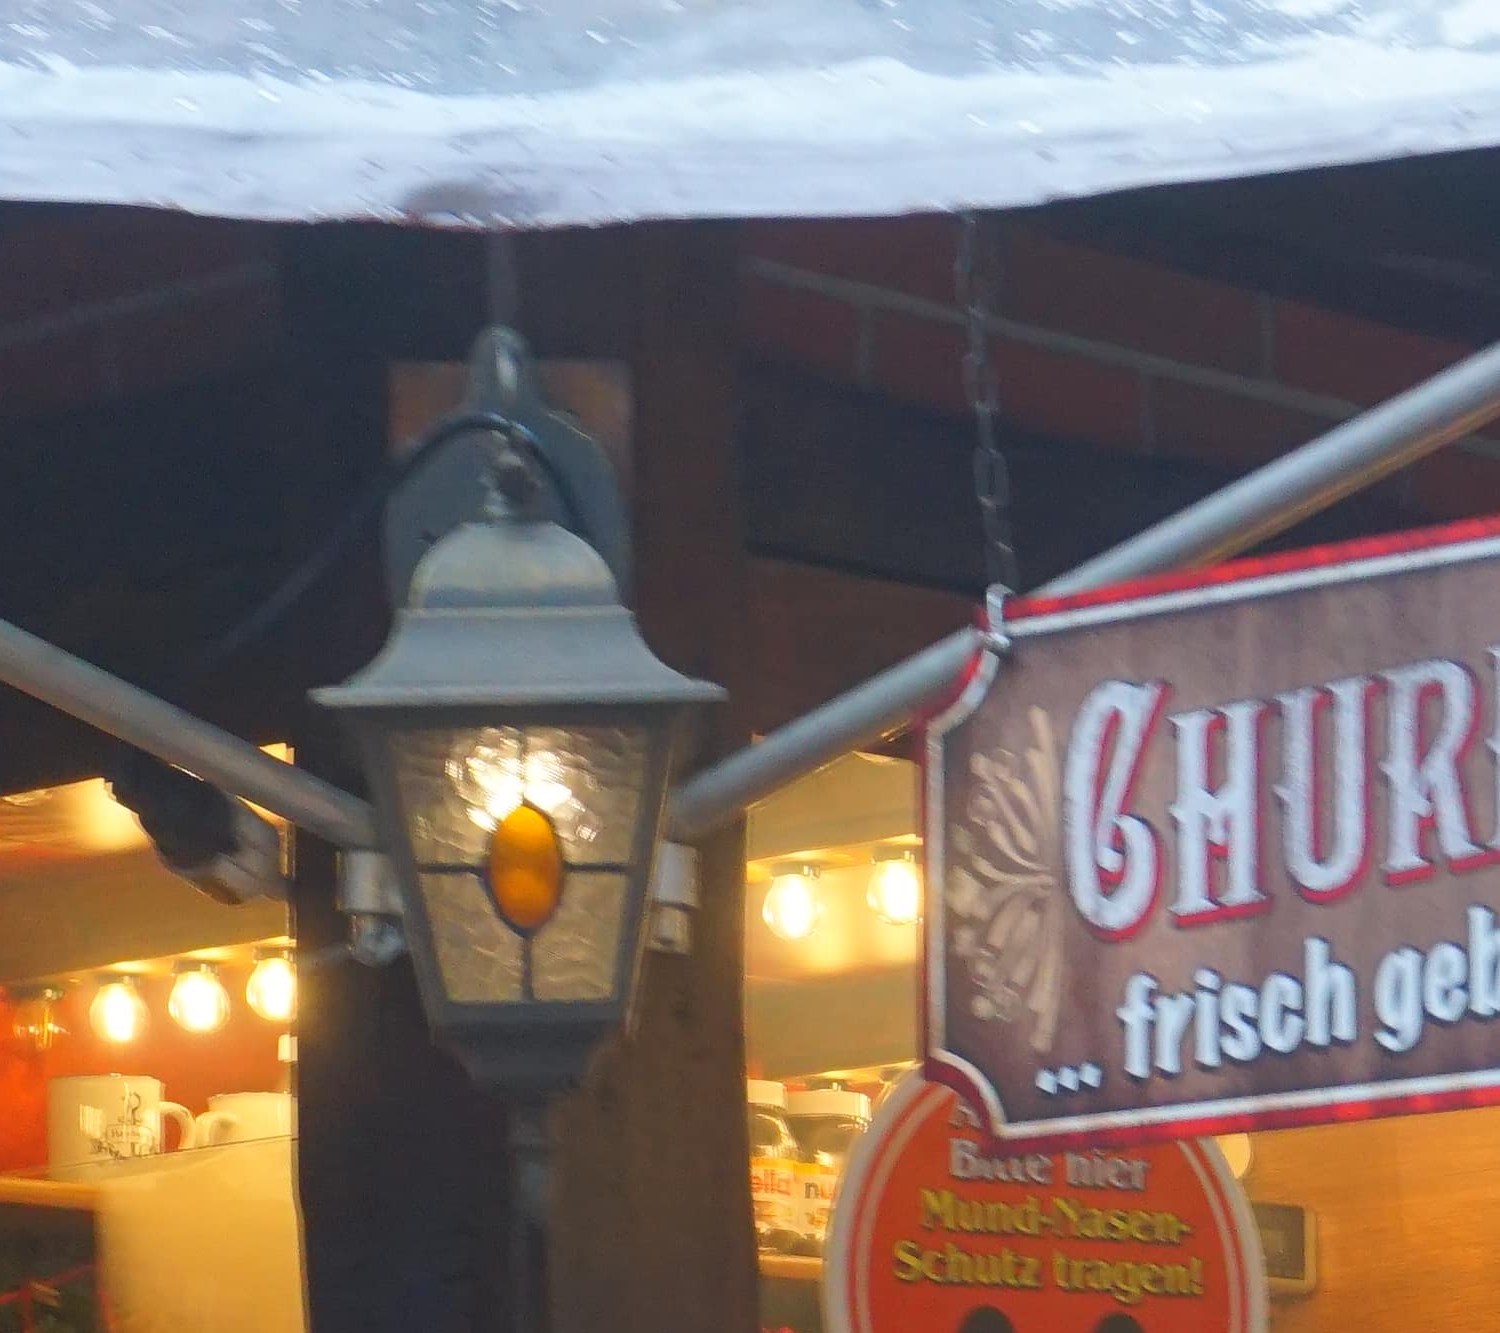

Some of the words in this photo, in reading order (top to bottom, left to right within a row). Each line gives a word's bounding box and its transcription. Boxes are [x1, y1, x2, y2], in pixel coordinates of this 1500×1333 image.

[1118, 938, 1358, 1082] frisch
[919, 1186, 1194, 1247] Mund-Nasen-
[891, 1239, 1043, 1289] Schutz
[1051, 1250, 1206, 1305] tragen!
